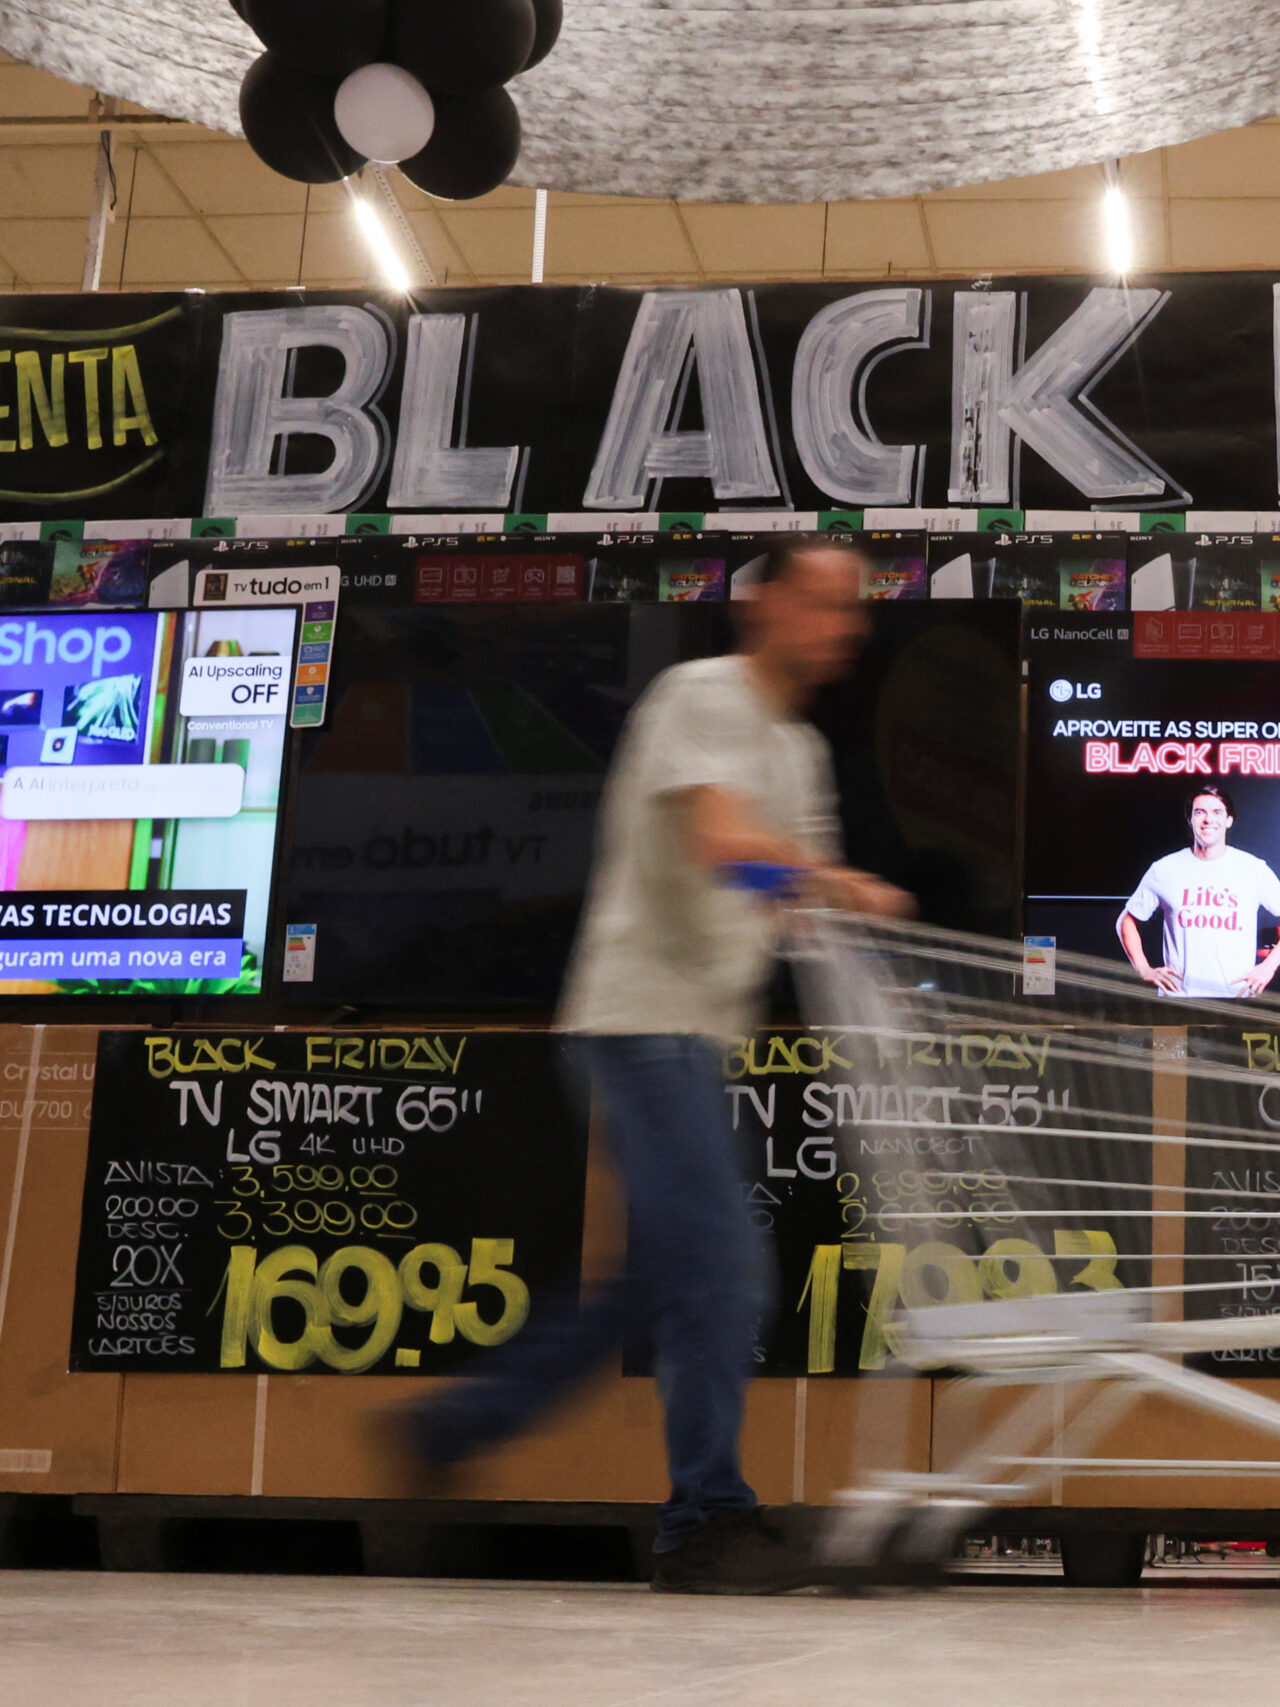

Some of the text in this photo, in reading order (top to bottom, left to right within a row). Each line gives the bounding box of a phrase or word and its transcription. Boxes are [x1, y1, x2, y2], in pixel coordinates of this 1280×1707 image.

[203, 286, 1192, 517] BLACK
[233, 541, 269, 550] PS5
[422, 537, 459, 547] PS5
[617, 534, 655, 544] PS5
[1015, 534, 1053, 544] PS5
[1215, 535, 1253, 545] PS5
[234, 583, 248, 592] TV
[249, 577, 302, 595] tudo
[303, 582, 322, 591] em
[354, 576, 382, 586] UHD
[1031, 628, 1049, 640] LG
[1054, 628, 1114, 640] NanoCell
[0, 622, 132, 677] Shop
[189, 664, 283, 681] AI Upscaling
[231, 684, 280, 705] OFF
[1076, 683, 1101, 699] LG
[187, 720, 274, 730] Conventional TV
[1053, 720, 1161, 737] APROVEITE
[1165, 721, 1191, 738] AS
[1195, 721, 1258, 738] SUPER
[1085, 741, 1211, 773] BLACK
[1182, 886, 1239, 908] Life's
[0, 903, 232, 927] AS TECNOLOGIAS
[1177, 909, 1243, 932] Good.
[71, 951, 121, 967] uma
[128, 951, 183, 966] nova
[189, 950, 227, 966] era
[145, 1036, 467, 1079] BLACK FRIDAY
[722, 1037, 855, 1080] BLACK
[3, 1063, 78, 1081] Crstal
[247, 1080, 381, 1127] SMART
[802, 1082, 963, 1129] SMART
[226, 1128, 405, 1164] LG 4K UHD
[765, 1136, 837, 1180] LG
[111, 1243, 185, 1287] 20X
[97, 1311, 176, 1332] NOSSOS
[88, 1331, 196, 1356] CARTÕES
